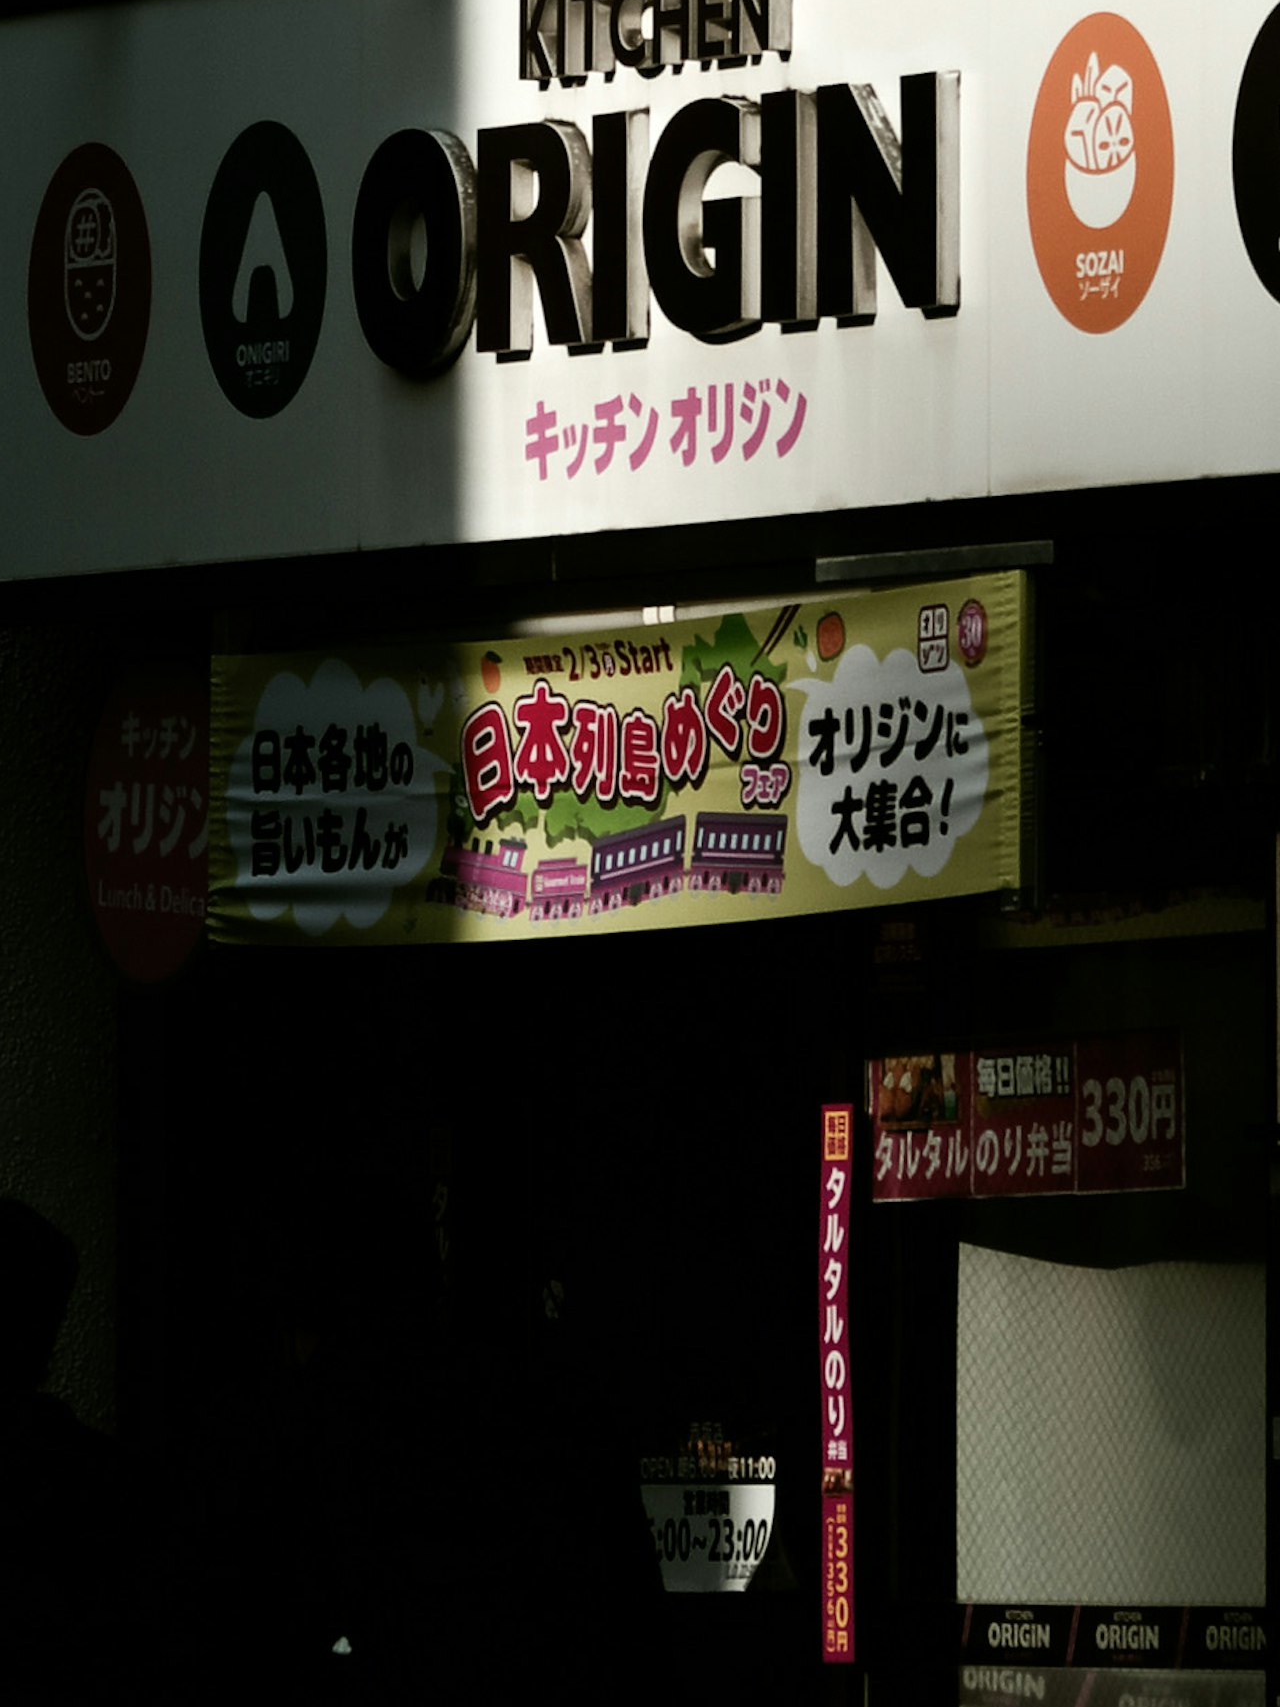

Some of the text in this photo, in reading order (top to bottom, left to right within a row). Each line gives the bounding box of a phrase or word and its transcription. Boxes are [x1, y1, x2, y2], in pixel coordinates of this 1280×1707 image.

[352, 70, 961, 376] ORIGIN
[1076, 250, 1125, 279] SOZAI
[67, 359, 112, 385] BENTO
[236, 340, 291, 367] ONIGIRI
[525, 378, 807, 481] キッチン オリジン
[613, 636, 674, 677] Start
[120, 711, 197, 762] キッチン
[252, 723, 414, 795] 日本各地の
[463, 664, 784, 824] 日本列島めぐり
[808, 696, 969, 776] オリジンに
[741, 763, 787, 804] フェア
[829, 775, 955, 855] 大集合!
[97, 780, 209, 861] オリジン
[251, 807, 411, 877] 旨いもんが
[97, 880, 143, 911] Lunch
[145, 885, 157, 912] &
[1080, 1074, 1176, 1147] 330円
[874, 1121, 1074, 1182] タルタルのり弁当
[823, 1166, 848, 1461] タルタルのり弁当
[834, 1525, 849, 1653] 330円
[987, 1622, 1051, 1649] ORIGIN
[1095, 1624, 1160, 1651] ORIGIN
[1205, 1625, 1267, 1653] ORIGIN
